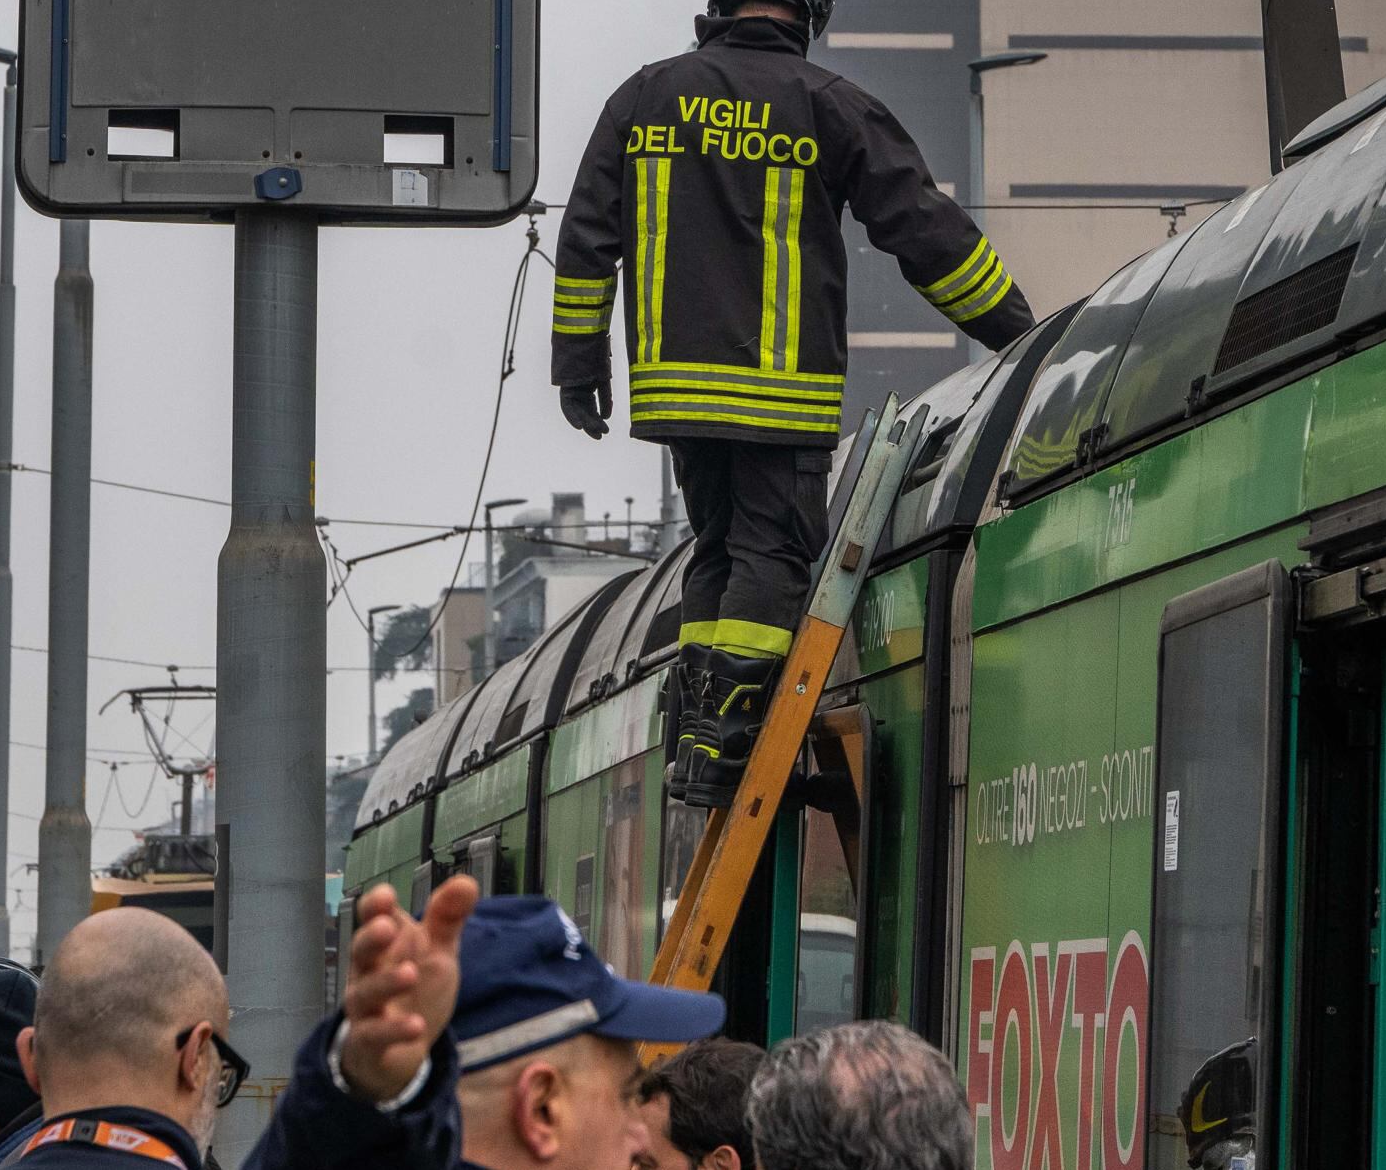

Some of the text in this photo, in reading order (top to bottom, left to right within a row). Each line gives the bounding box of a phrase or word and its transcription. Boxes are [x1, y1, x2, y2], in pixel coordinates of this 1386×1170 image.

[626, 125, 819, 166] DEL FUOCO
[678, 96, 771, 130] VIGILI
[1104, 477, 1136, 549] 7515
[869, 589, 895, 654] 19.00
[976, 776, 1011, 845] OLTRE
[1012, 761, 1038, 847] 160
[1039, 759, 1088, 835] NEGOZI
[1099, 745, 1154, 825] SCONTI
